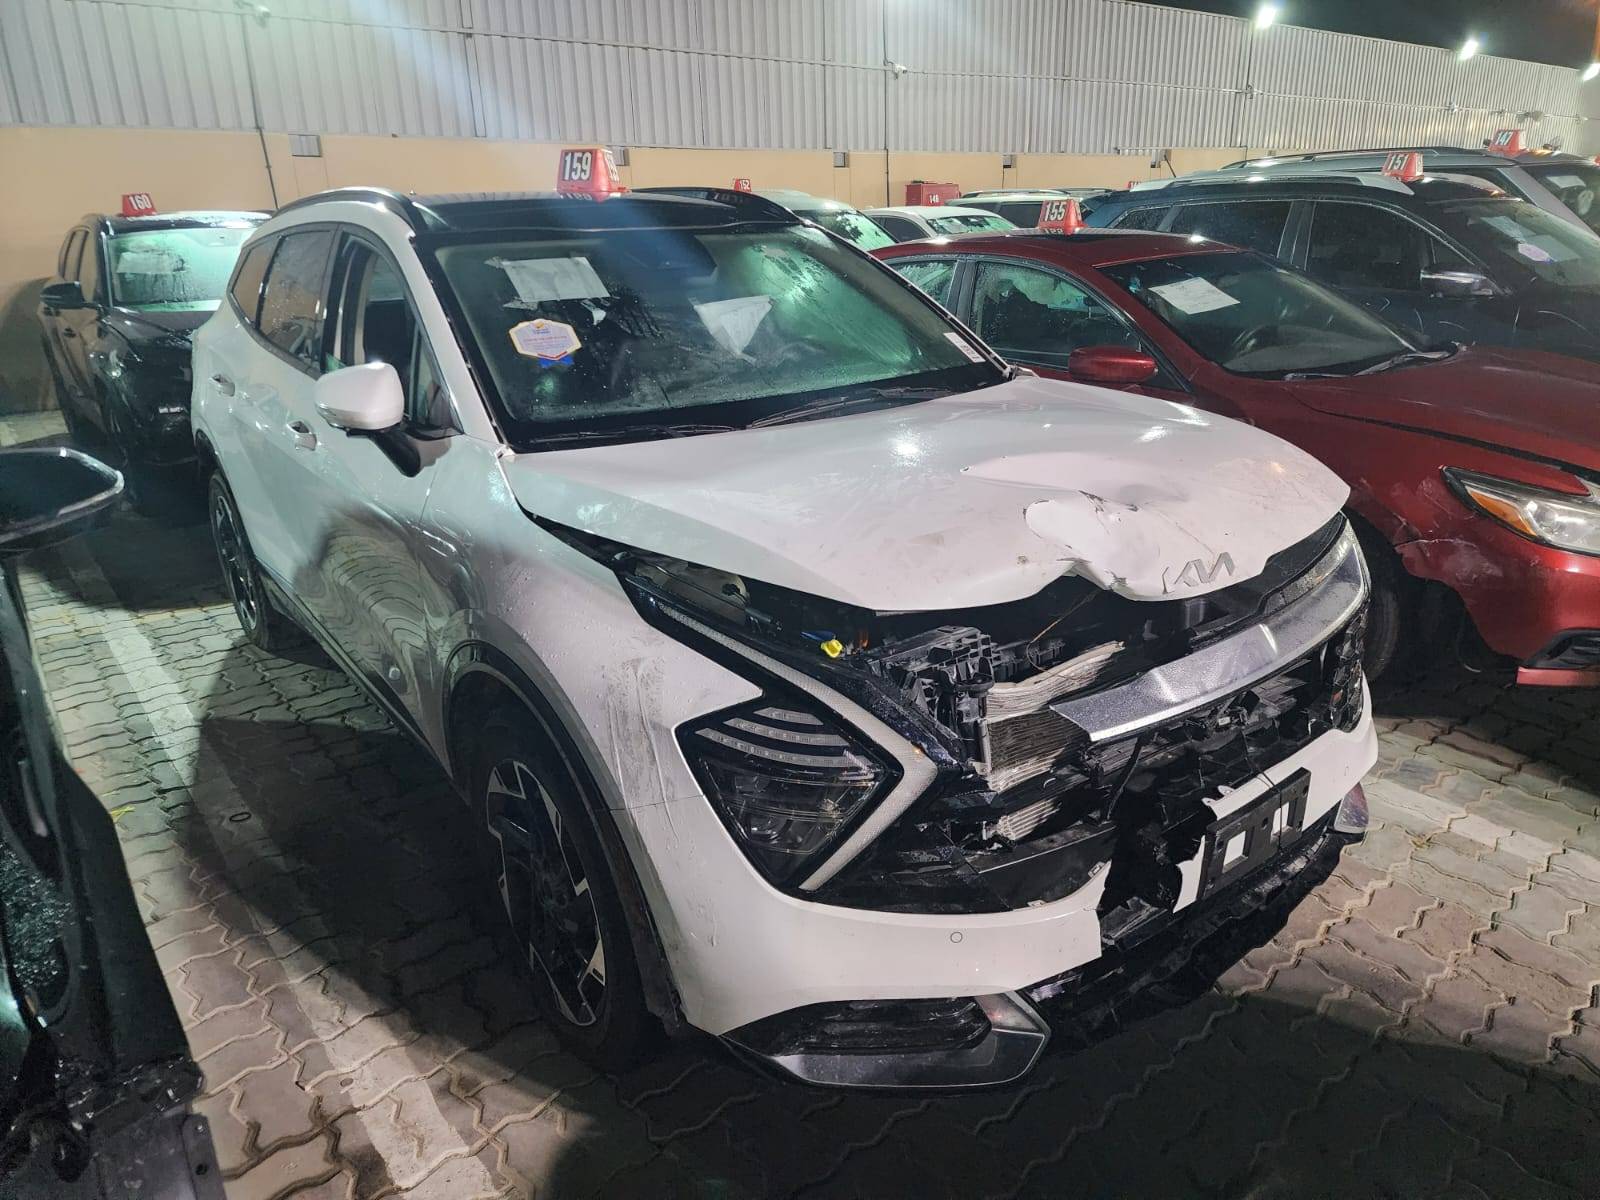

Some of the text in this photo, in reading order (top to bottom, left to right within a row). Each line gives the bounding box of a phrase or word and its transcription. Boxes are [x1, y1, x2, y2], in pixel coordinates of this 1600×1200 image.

[564, 151, 592, 180] 159
[129, 194, 153, 210] 160
[1044, 201, 1066, 221] 155
[1162, 551, 1236, 595] KIA
